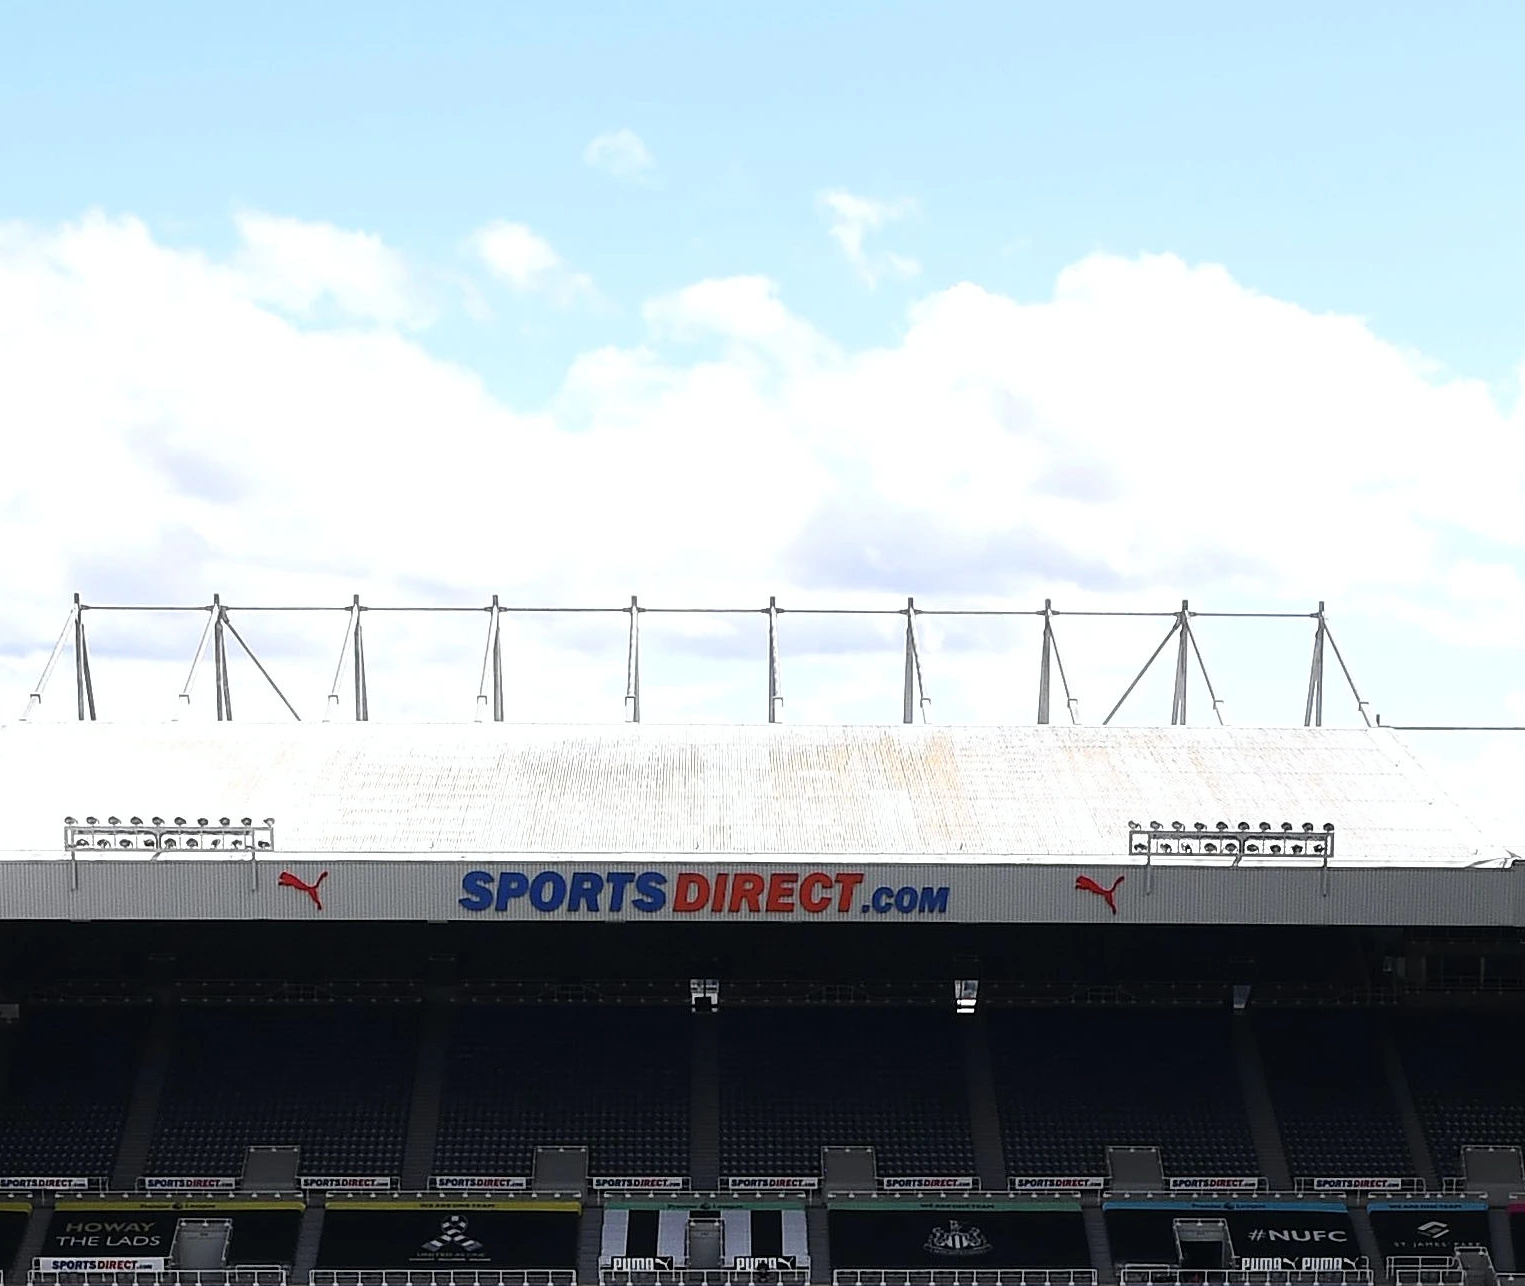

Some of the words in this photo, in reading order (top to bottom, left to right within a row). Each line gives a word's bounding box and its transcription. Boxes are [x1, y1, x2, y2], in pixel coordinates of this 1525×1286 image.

[66, 1221, 156, 1233] HOWAY
[56, 1236, 101, 1247] THE
[111, 1236, 161, 1247] LADS
[1248, 1230, 1348, 1242] #NUFC
[613, 1257, 654, 1270] PUMA
[1241, 1257, 1282, 1270] PUMA
[1301, 1257, 1342, 1270] PUMA
